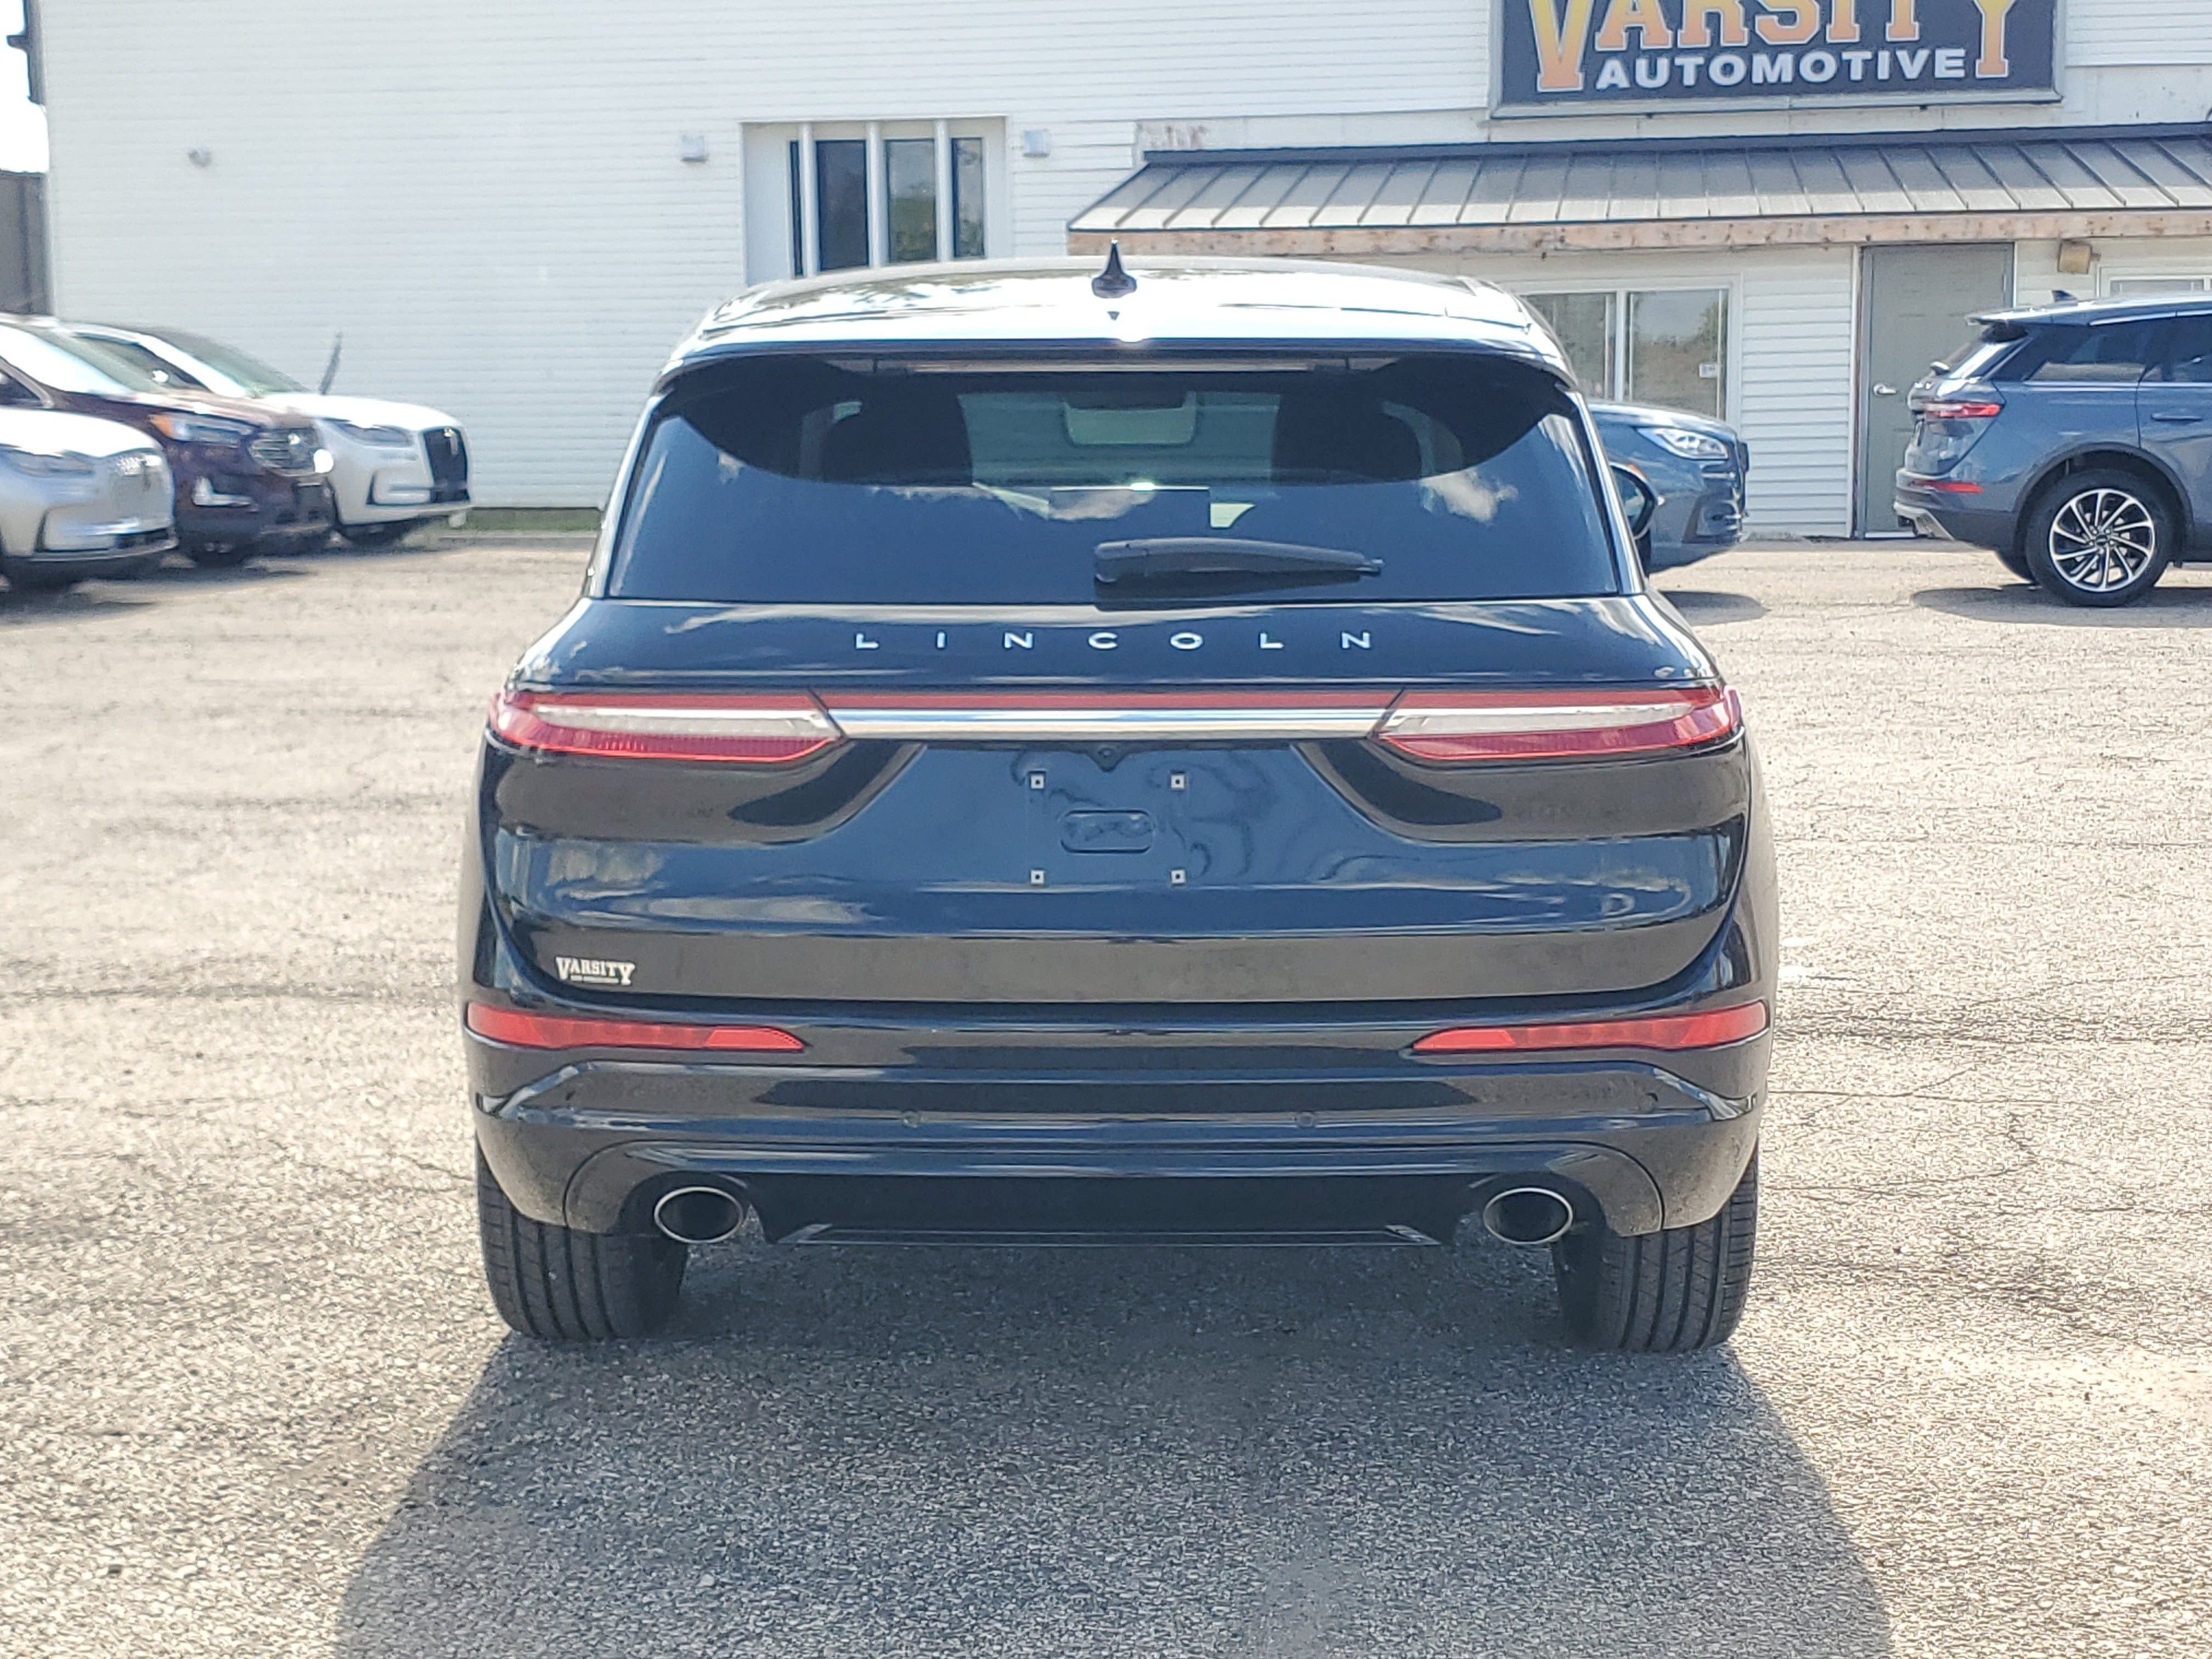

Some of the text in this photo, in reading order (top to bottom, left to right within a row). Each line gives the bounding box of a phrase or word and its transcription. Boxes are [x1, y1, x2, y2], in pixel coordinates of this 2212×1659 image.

[1595, 49, 1966, 89] AUTOMOTIVE
[855, 632, 1371, 649] LINCOLN
[555, 956, 636, 985] VARSITY
